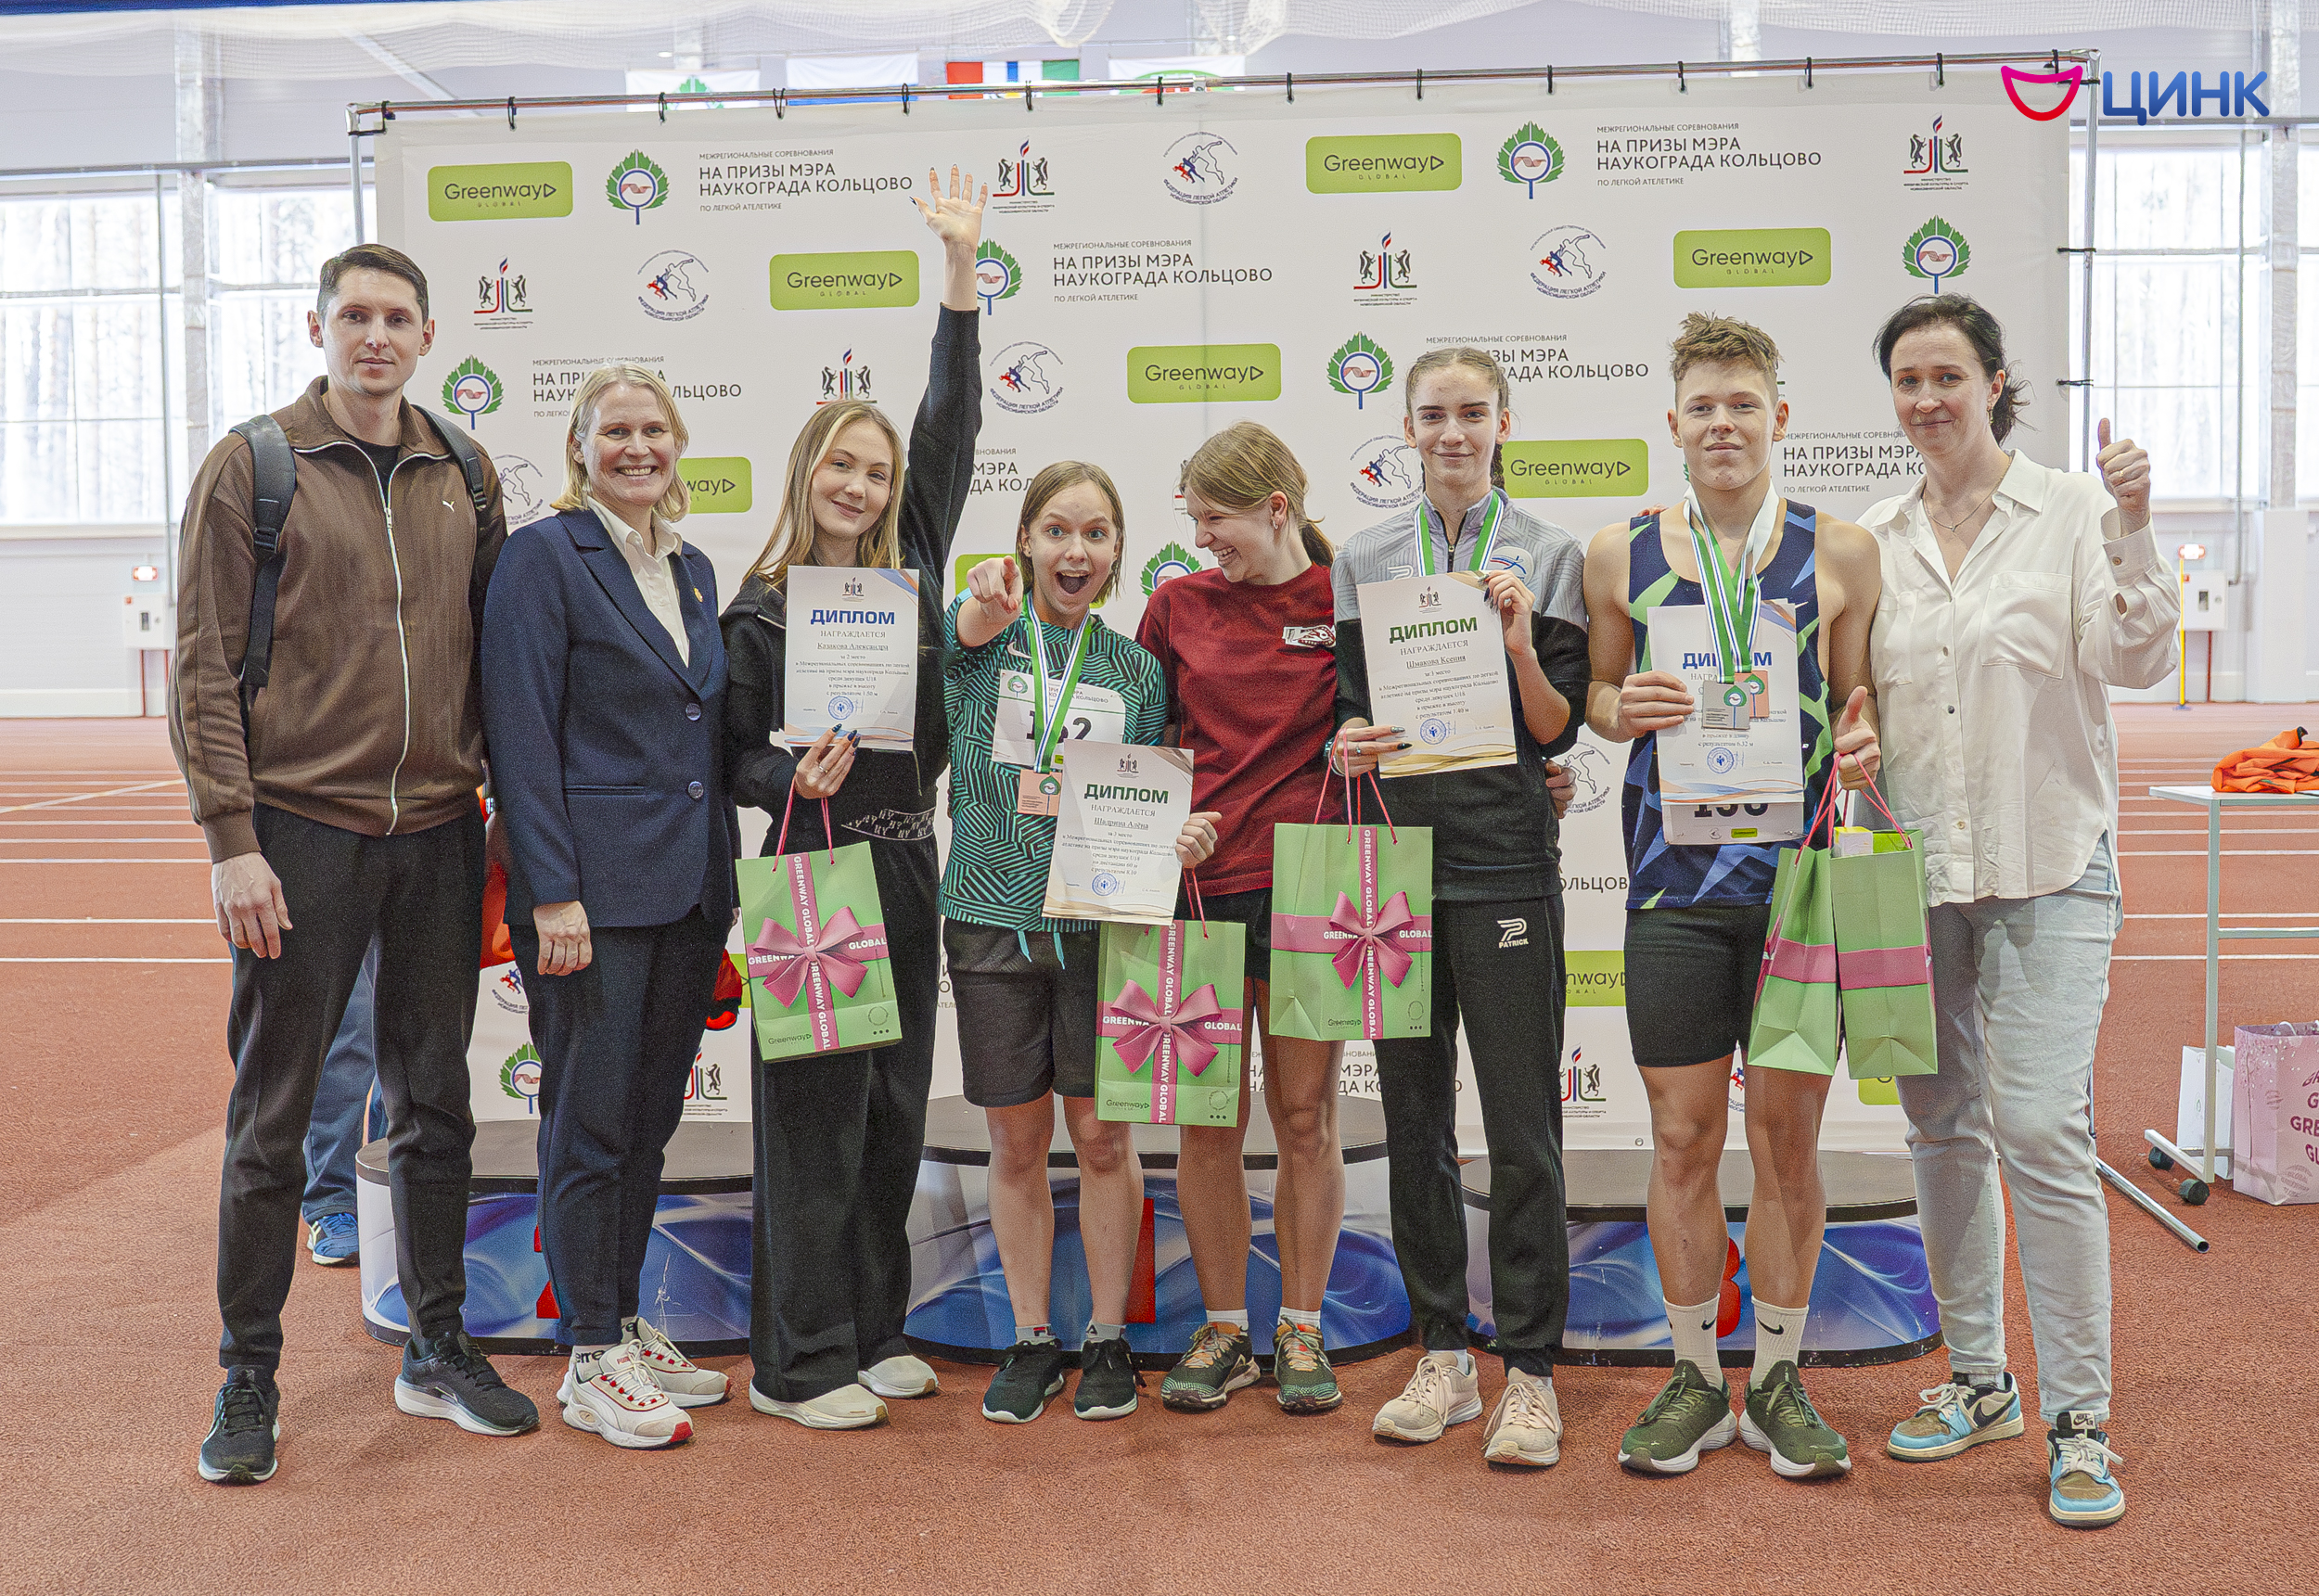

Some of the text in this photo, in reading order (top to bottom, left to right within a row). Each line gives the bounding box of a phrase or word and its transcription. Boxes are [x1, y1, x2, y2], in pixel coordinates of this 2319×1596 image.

[1596, 136, 1742, 154] НА ПРИЗЫ МЭРА
[1324, 154, 1429, 173] Greenway
[1596, 151, 1822, 172] НАУКОГРАДА КОЛЬЦОВО
[699, 162, 836, 180] НА ПРИЗЫ МЭРА
[699, 176, 913, 198] НАУКОГРАДА КОЛЬЦОВО
[1597, 178, 1609, 186] ПО
[444, 183, 543, 201] Greenway
[699, 204, 711, 212] ПО
[1053, 253, 1194, 271] НА ПРИЗЫ МЭРА
[1692, 248, 1800, 268] Greenway
[788, 272, 888, 290] Greenway
[1054, 268, 1273, 287] НАУКОГРАДА КОЛЬЦОВО
[1054, 295, 1066, 303] ПО
[1505, 334, 1568, 343] СОРЕВНОВАНИЯ
[1520, 348, 1569, 363] МЭРА
[532, 372, 556, 386] НА
[1145, 364, 1250, 384] Greenway
[1548, 363, 1648, 380] КОЛЬЦОВО
[672, 384, 742, 402] ЛЬЦОВО
[545, 409, 570, 417] ЛЕГКО
[1783, 446, 1808, 460] НА
[1813, 445, 1873, 460] ПРИЗЫ
[1510, 459, 1618, 479] Greenway
[1783, 462, 1901, 479] НАУКОГРАДА
[1783, 485, 1796, 493] ПО
[810, 609, 895, 625] ДИПЛОМ
[820, 630, 886, 638] НАГРАЖДАЕТСЯ
[1390, 617, 1478, 644] ДИПЛОМ
[1400, 640, 1468, 656] НАГРАЖДАЕТСЯ
[1083, 784, 1169, 804] ДИПЛОМ
[1091, 804, 1156, 817] НАГРАЖДАЕТСЯ
[1364, 829, 1372, 884] GREENWAY
[1562, 876, 1628, 891] ОЛЬЦОВ
[793, 856, 814, 945] GREENWAY GLOBAL
[1399, 929, 1433, 938] GLOBAL
[849, 937, 888, 951] GLOBAL
[1498, 938, 1529, 949] PATRICK
[1164, 923, 1177, 1015] GREENWAY GLOBAL
[1204, 1021, 1242, 1031] GLOBAL
[1368, 999, 1377, 1040] GLOBAL
[768, 1033, 807, 1045] Greenway
[818, 1012, 831, 1051] GLOBAL
[1106, 1100, 1145, 1109] Greenway
[1158, 1084, 1168, 1123] GLOBAL
